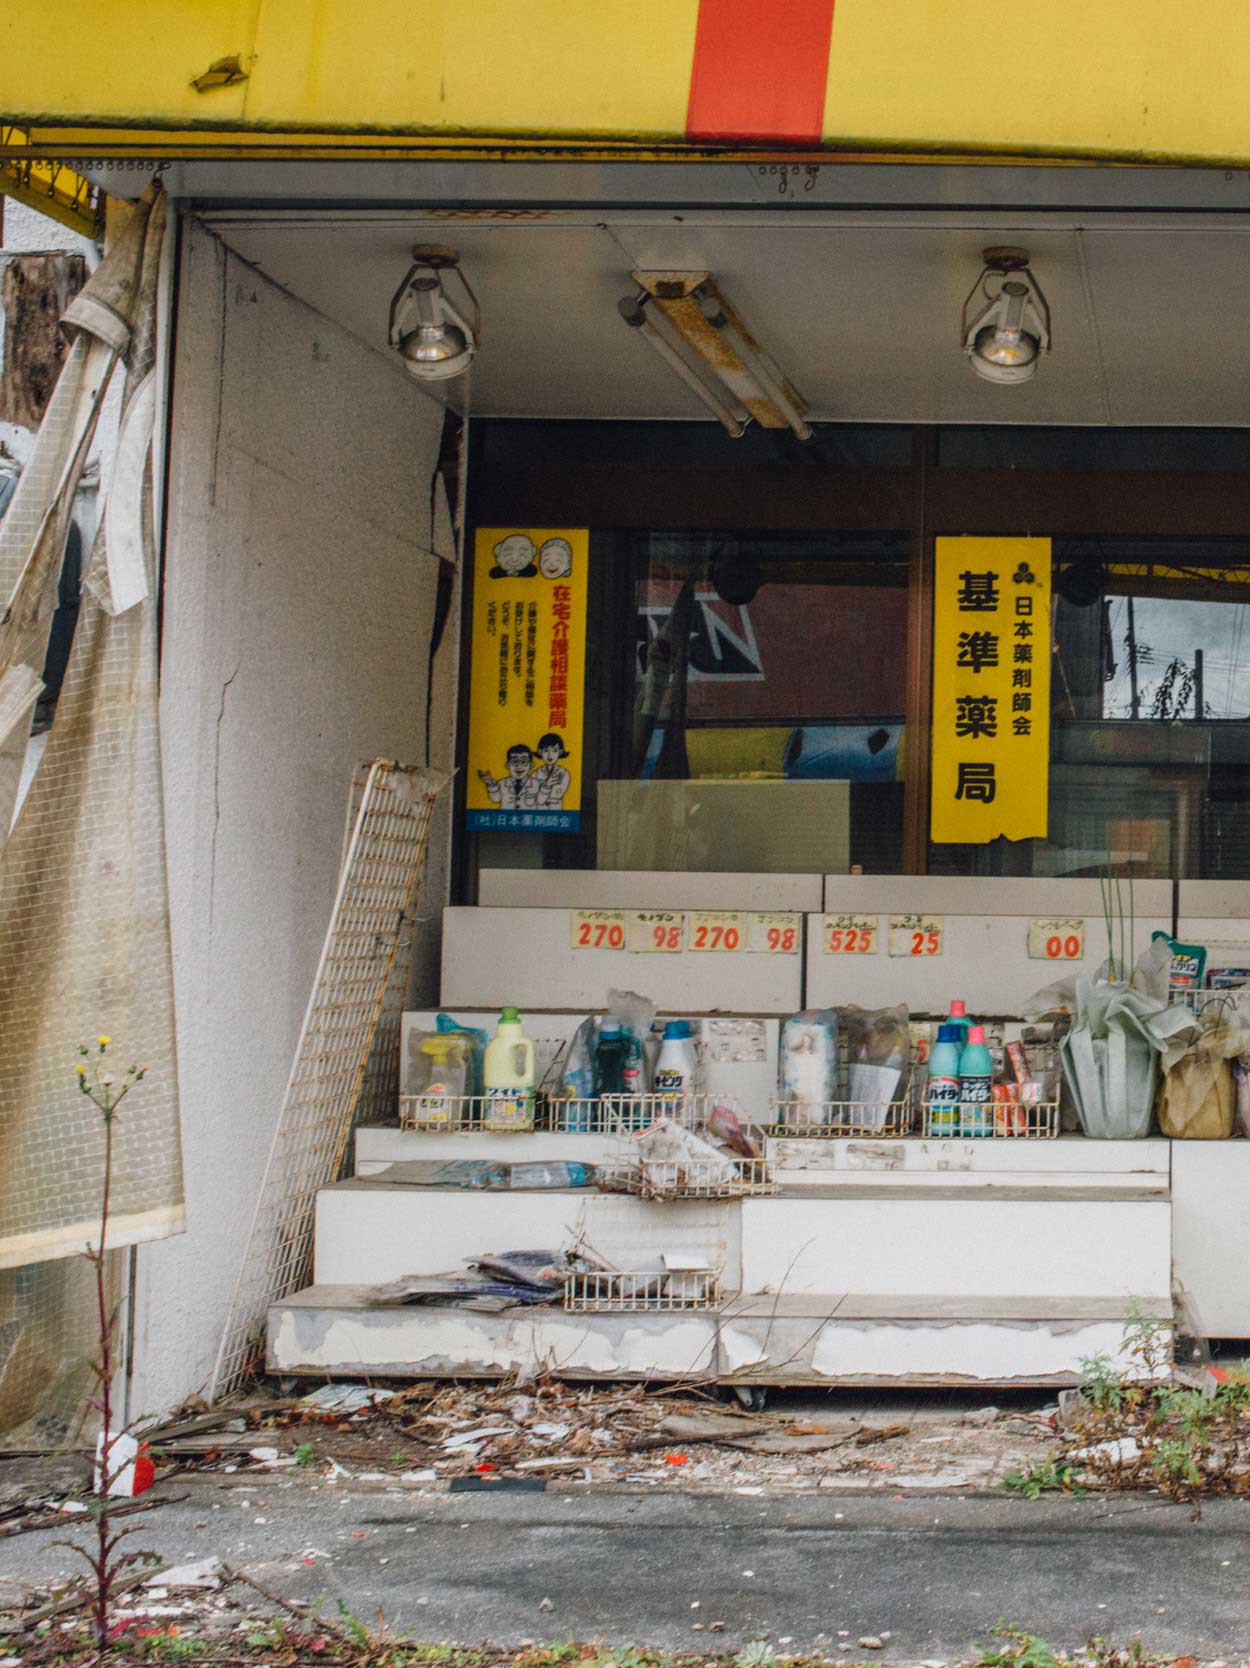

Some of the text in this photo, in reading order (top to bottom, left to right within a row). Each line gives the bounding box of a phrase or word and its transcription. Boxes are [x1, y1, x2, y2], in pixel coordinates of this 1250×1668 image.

[548, 584, 572, 729] 在宅介護相談薬局
[1012, 596, 1034, 736] 日本薬剤師会
[955, 570, 999, 804] 基準薬局
[579, 922, 624, 947] 270
[653, 925, 682, 948] 98
[694, 925, 740, 950] 270
[767, 927, 796, 950] 98
[829, 929, 873, 953] 525
[911, 930, 940, 955] 25
[1045, 935, 1080, 958] 00
